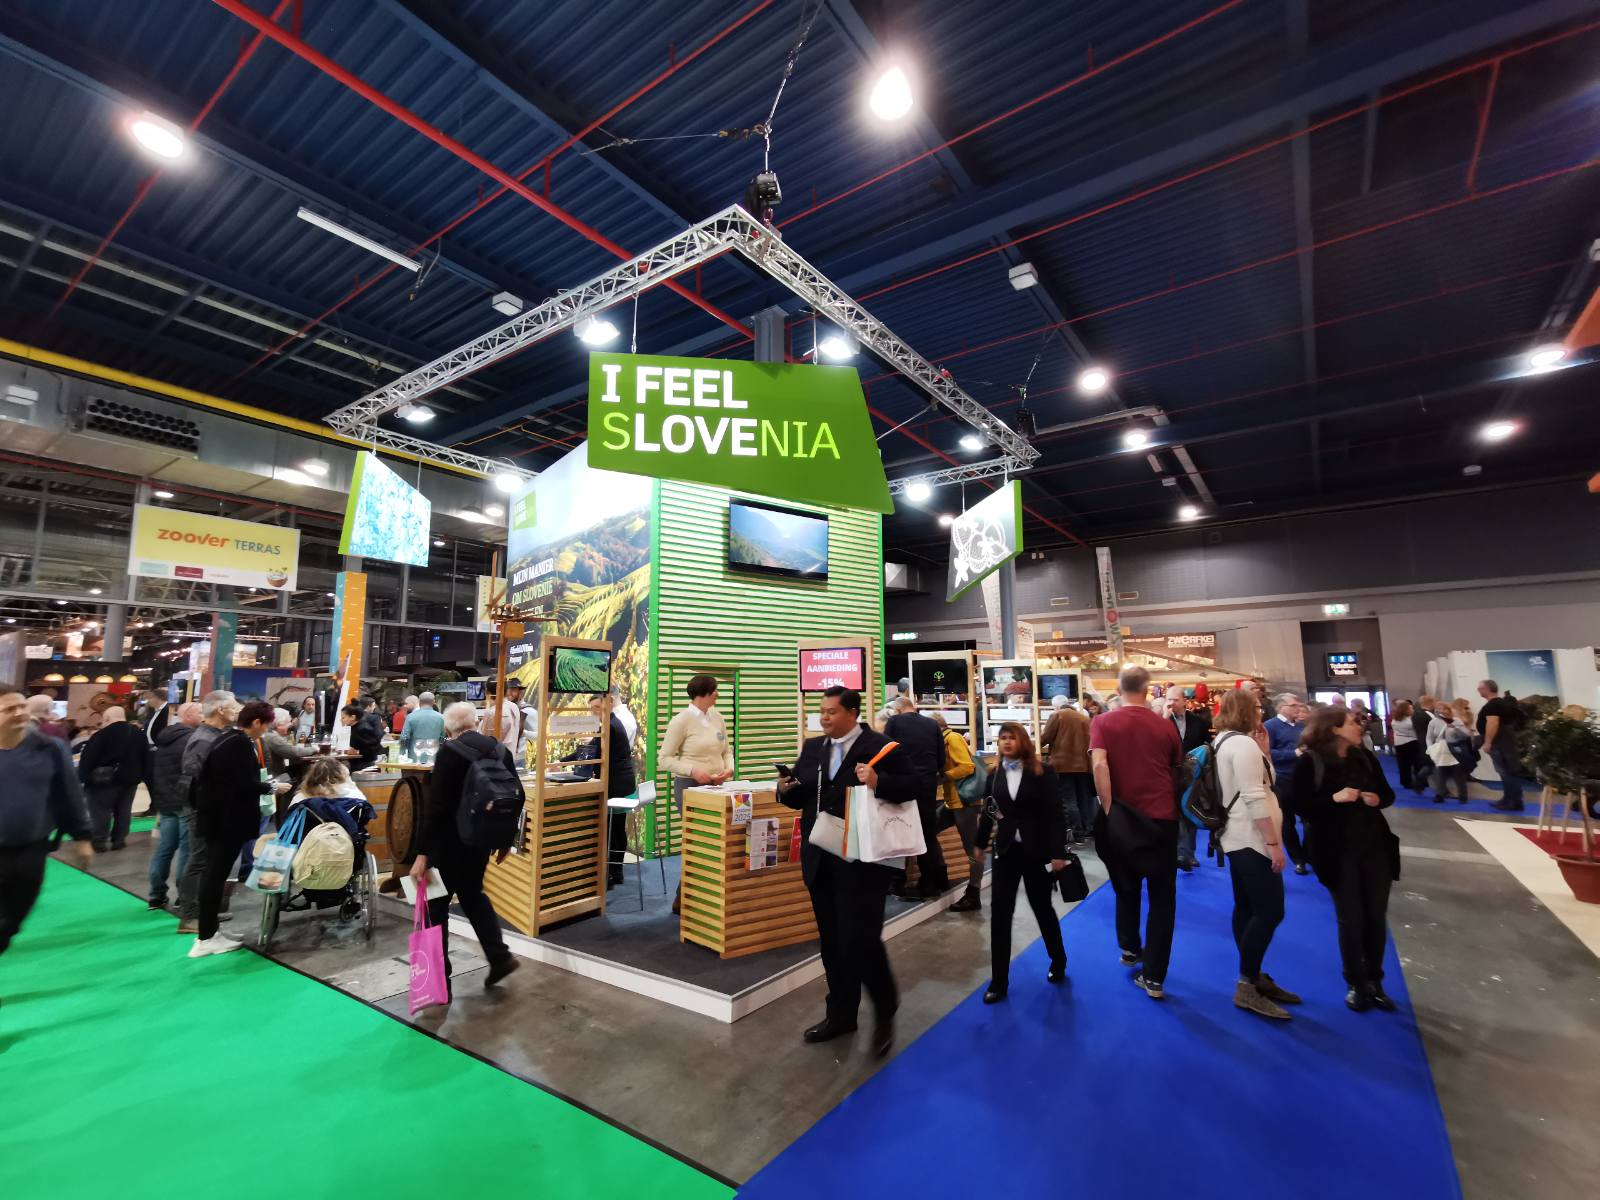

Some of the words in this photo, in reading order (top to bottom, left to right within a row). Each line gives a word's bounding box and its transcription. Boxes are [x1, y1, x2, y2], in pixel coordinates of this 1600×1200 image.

[601, 364, 622, 403] I
[636, 366, 748, 409] FEEL
[602, 412, 841, 459] SLOVENIA
[157, 528, 231, 549] zoover
[234, 539, 281, 556] TERRAS
[806, 663, 858, 673] AANBIEDING
[812, 651, 849, 661] SPECIALE
